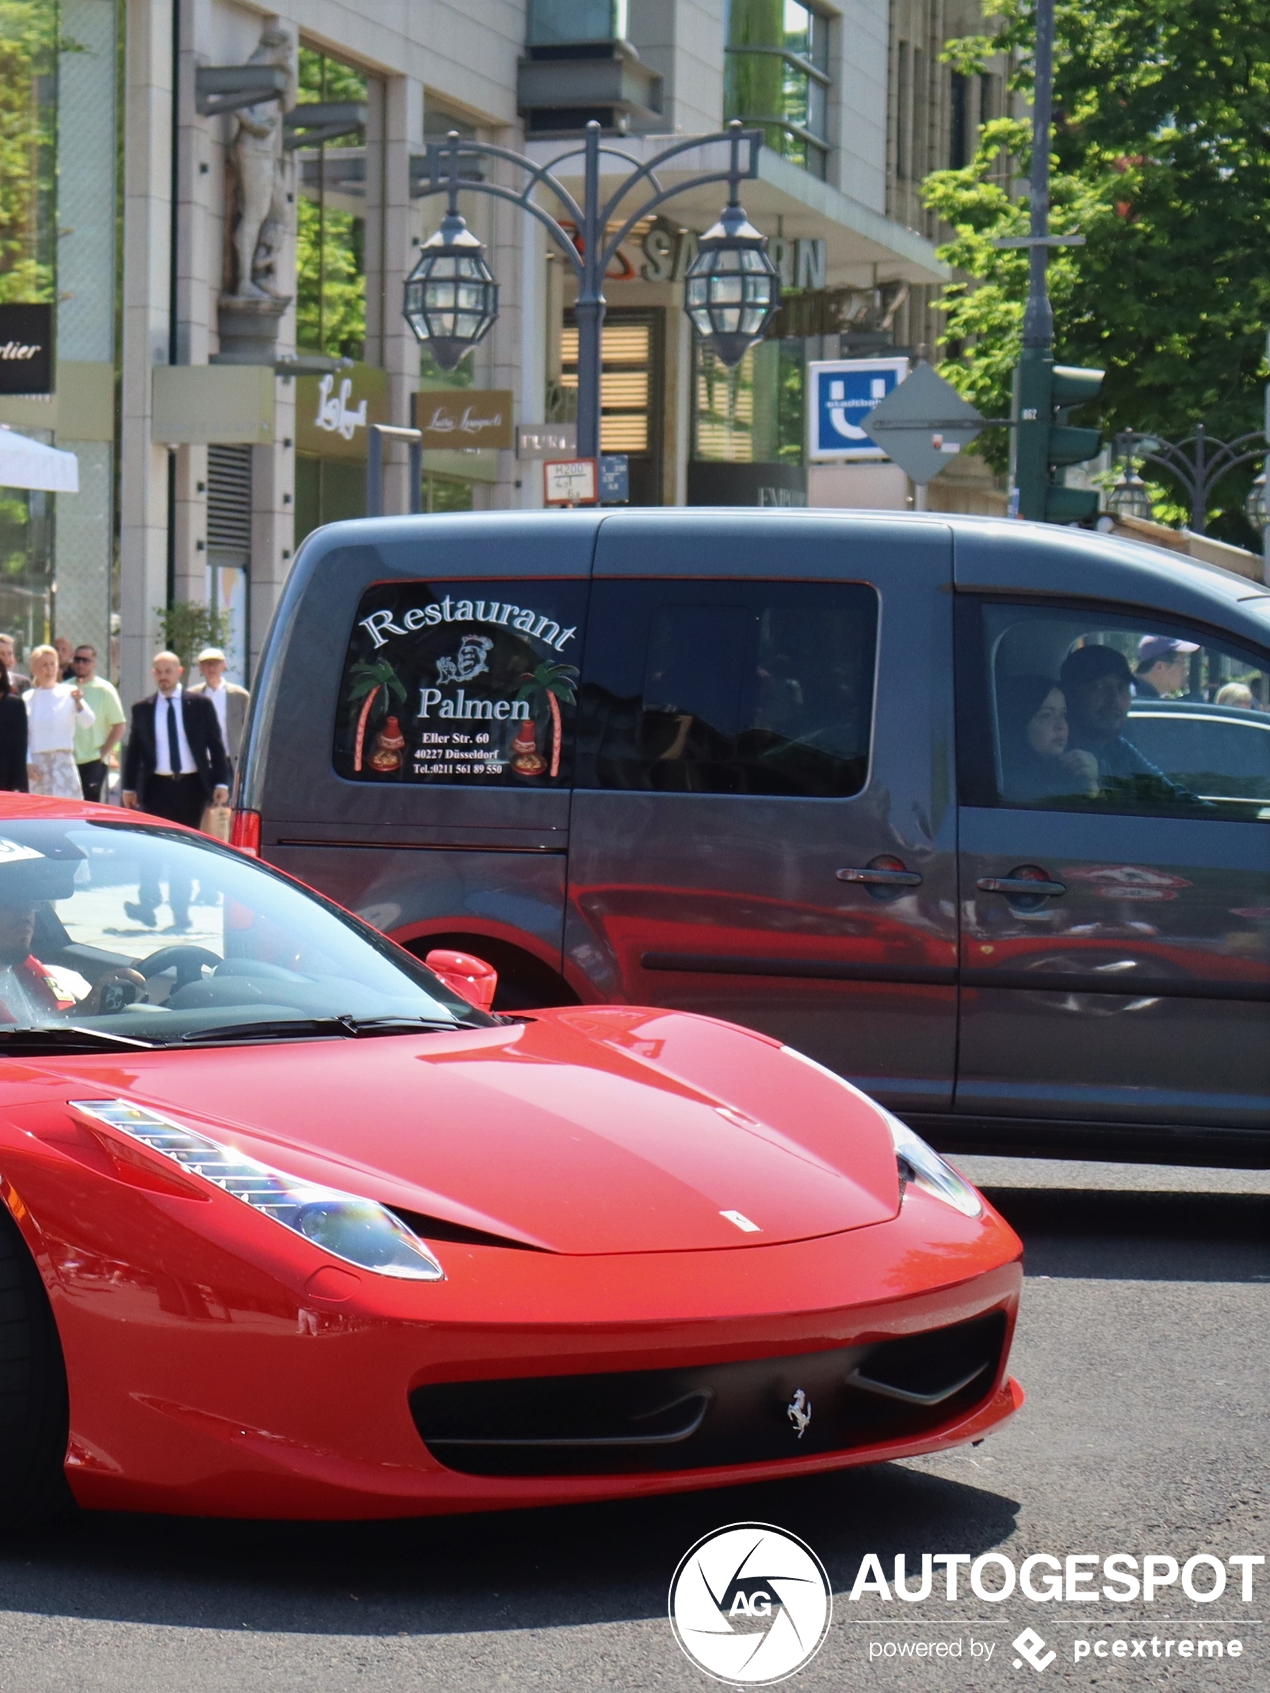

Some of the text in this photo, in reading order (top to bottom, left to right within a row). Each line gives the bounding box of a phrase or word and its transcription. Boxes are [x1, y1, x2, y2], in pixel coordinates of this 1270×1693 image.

[642, 229, 827, 289] SARN
[826, 399, 882, 408] stadtbah
[555, 464, 584, 475] H200
[359, 594, 577, 652] Restaurant
[417, 688, 530, 720] Palmen
[422, 733, 490, 744] Eller Str. 60
[414, 749, 499, 759] 40227 Düsseldorf
[455, 765, 471, 774] 561
[473, 764, 485, 774] 89
[486, 764, 503, 774] 550
